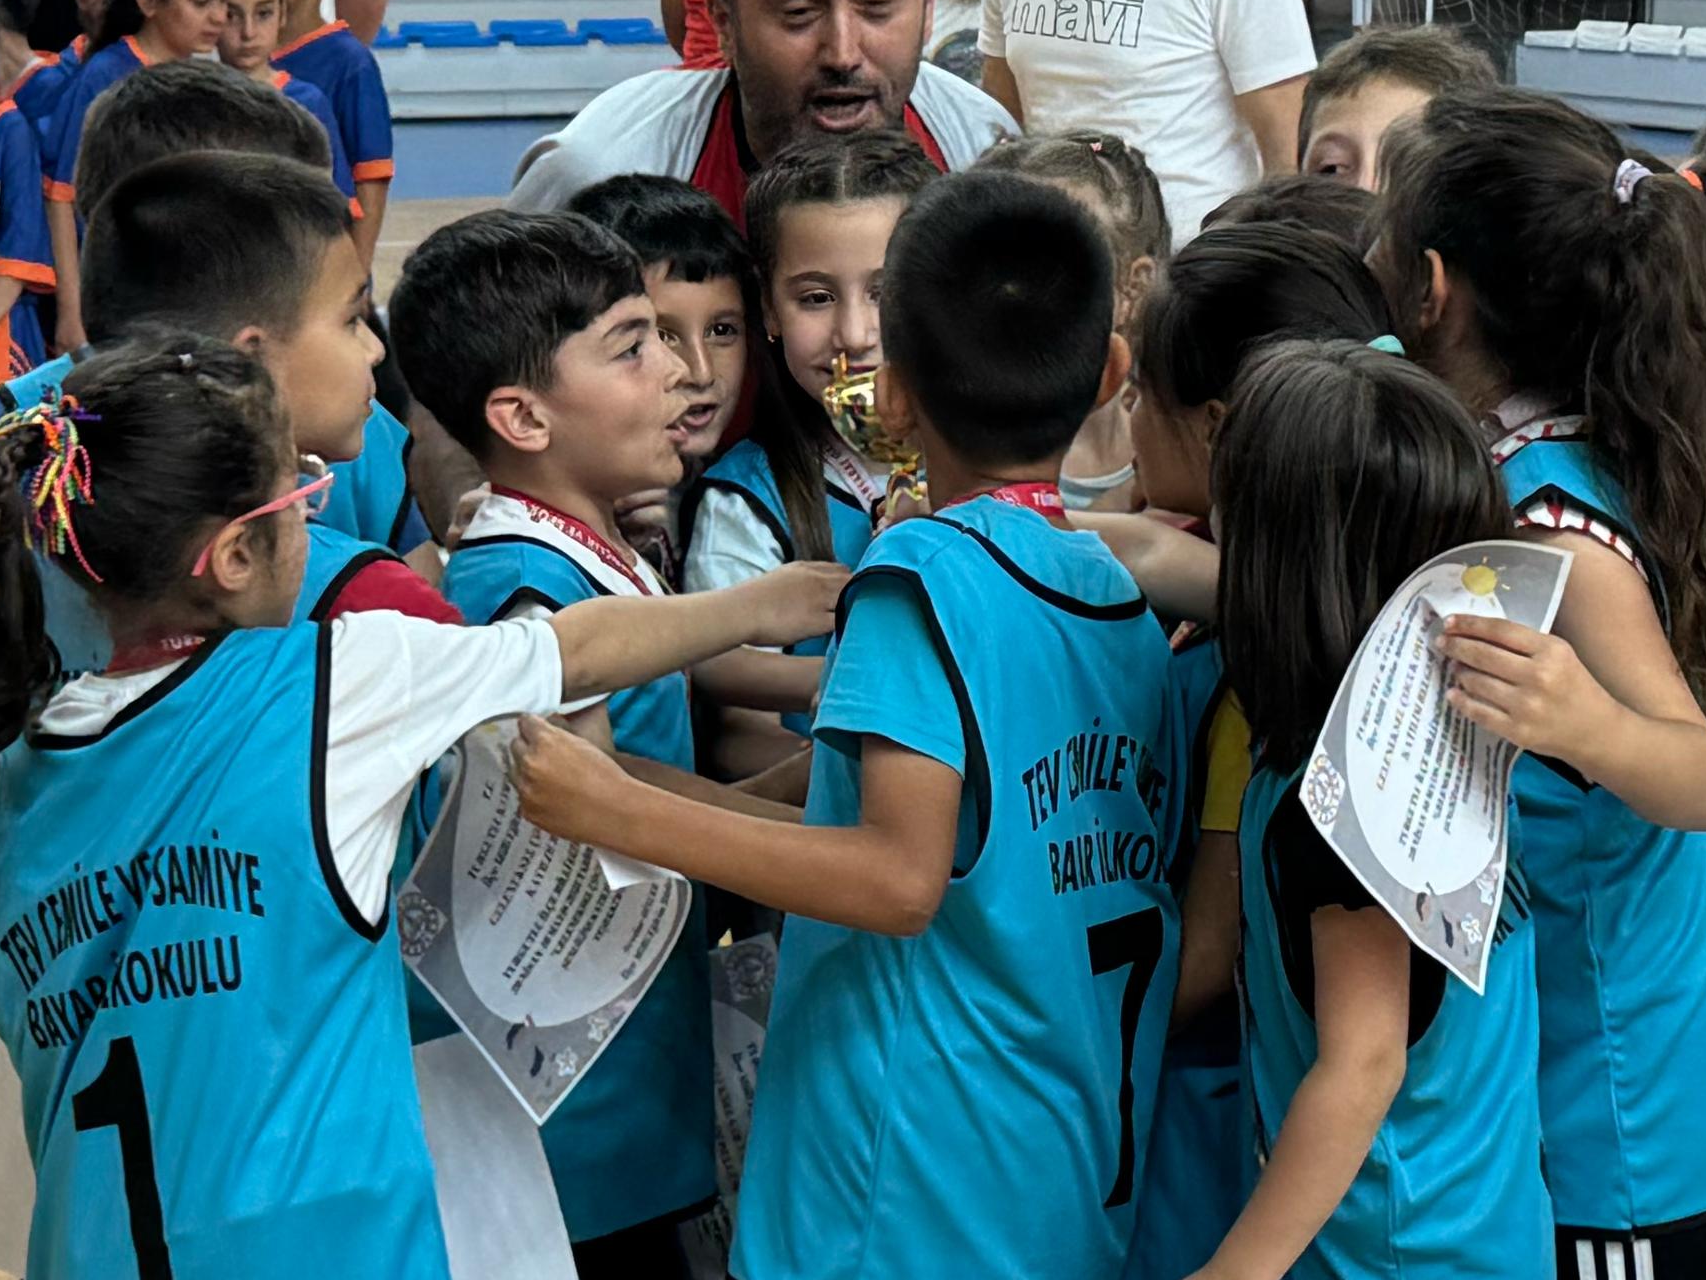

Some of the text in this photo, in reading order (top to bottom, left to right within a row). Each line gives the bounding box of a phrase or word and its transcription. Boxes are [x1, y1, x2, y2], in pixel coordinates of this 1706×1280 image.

[1022, 749, 1061, 832] TEV
[0, 914, 47, 993] TEV
[149, 827, 265, 918] SAMİYE
[1086, 906, 1165, 1208] 7
